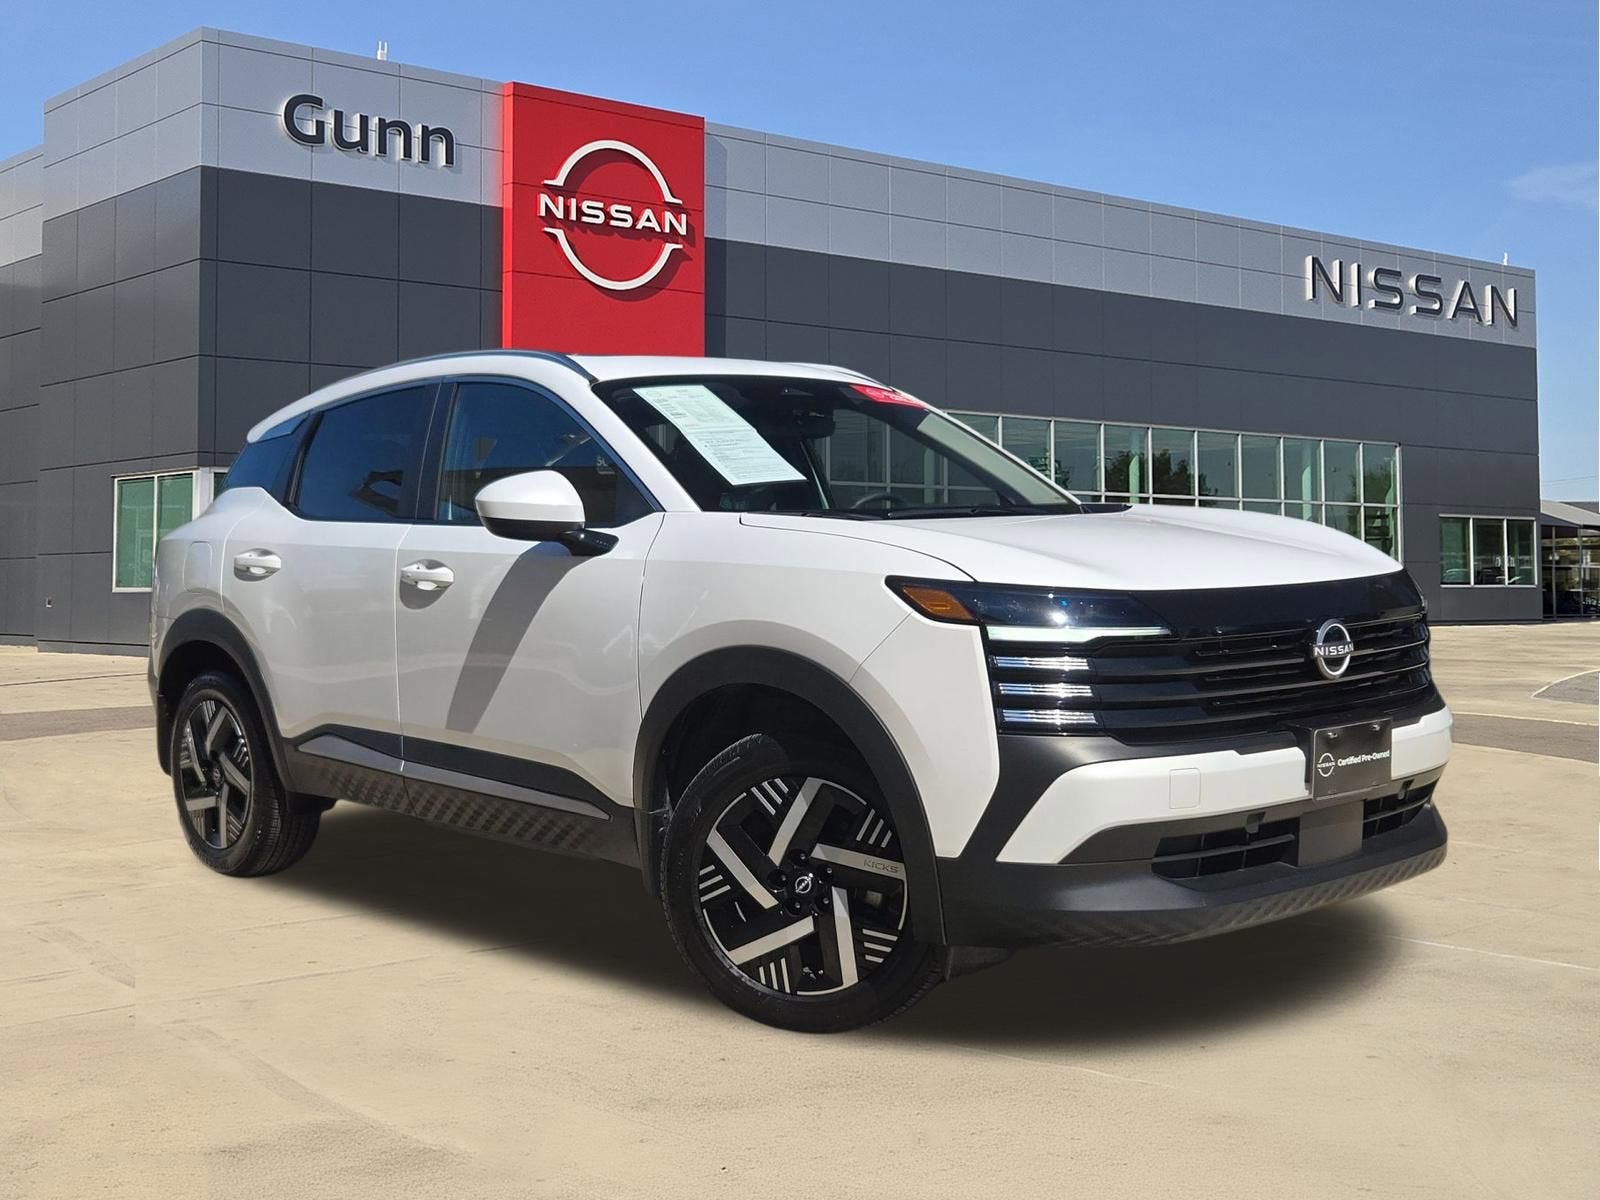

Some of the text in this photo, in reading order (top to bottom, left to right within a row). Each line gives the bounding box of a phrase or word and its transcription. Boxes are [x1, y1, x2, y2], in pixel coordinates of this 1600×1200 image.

[282, 94, 455, 166] Gunn
[537, 193, 687, 236] NISSAN
[1305, 255, 1517, 328] NISSAN
[1314, 643, 1354, 656] NISSAN
[1337, 750, 1390, 767] Certified Pre-Owned
[864, 859, 899, 873] KICKS
